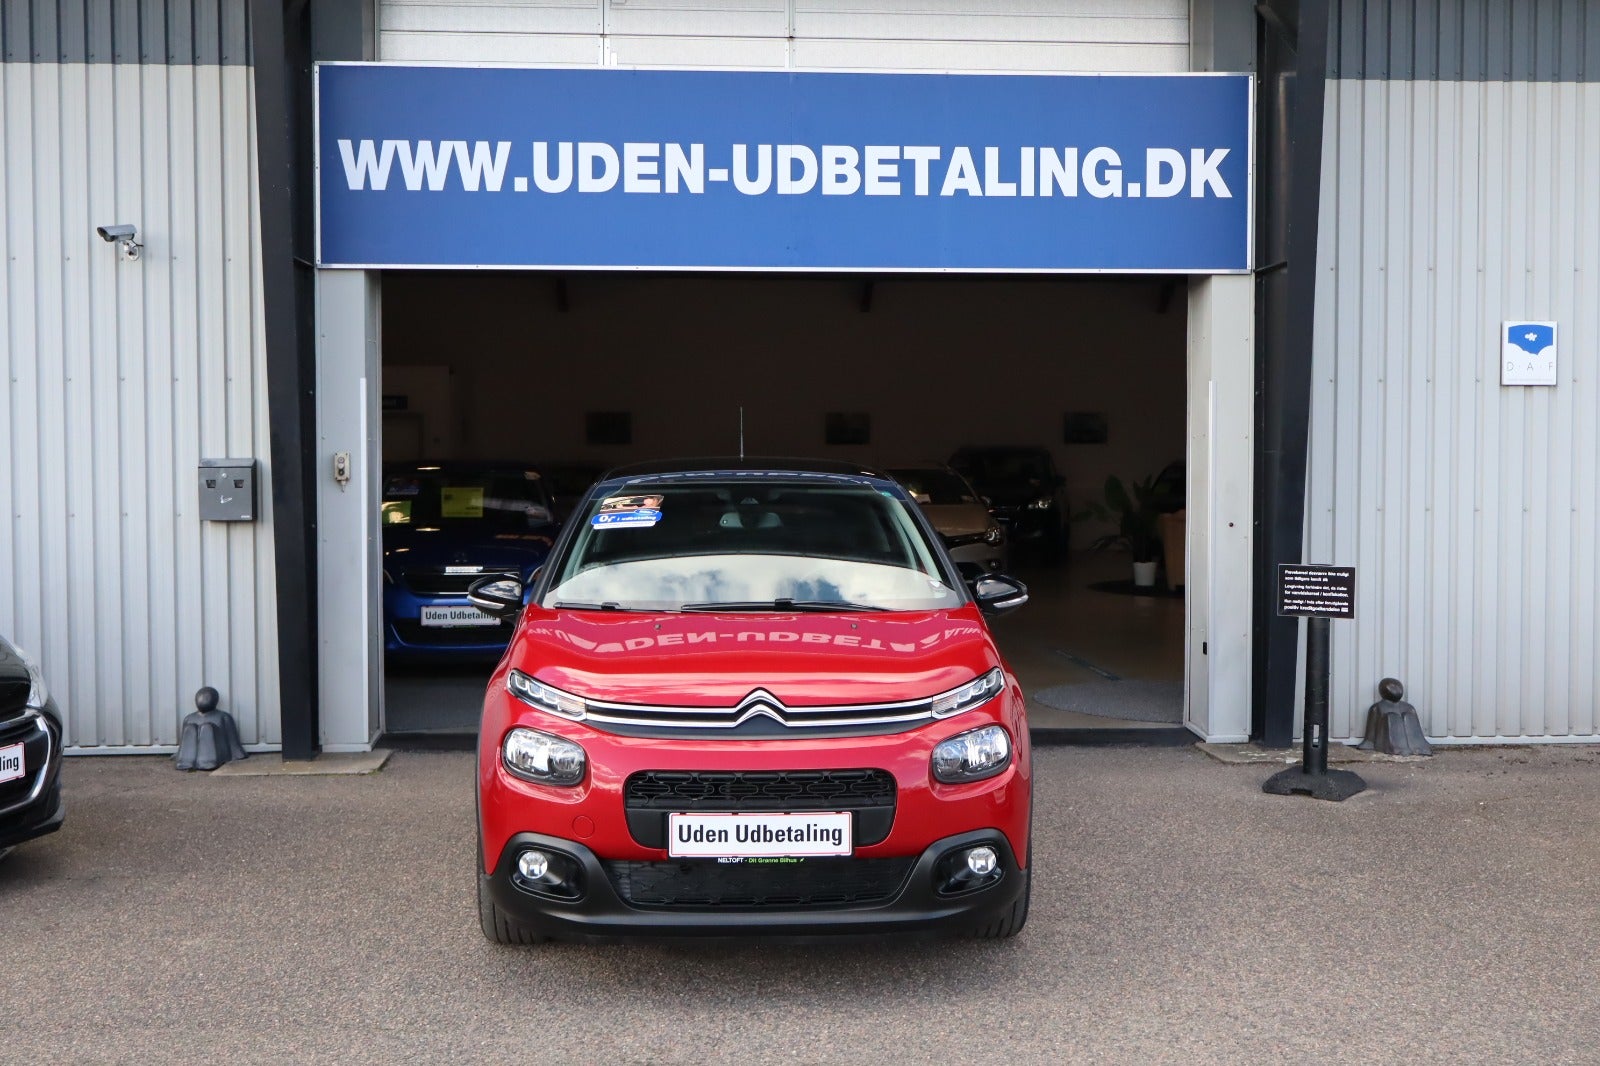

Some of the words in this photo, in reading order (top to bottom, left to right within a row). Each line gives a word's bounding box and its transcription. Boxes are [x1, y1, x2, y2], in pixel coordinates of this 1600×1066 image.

[337, 139, 1233, 198] WWW.UDEN-UDBETALING.DK
[425, 611, 448, 620] Uden
[678, 824, 729, 843] Uden
[735, 823, 843, 846] Udbetaling
